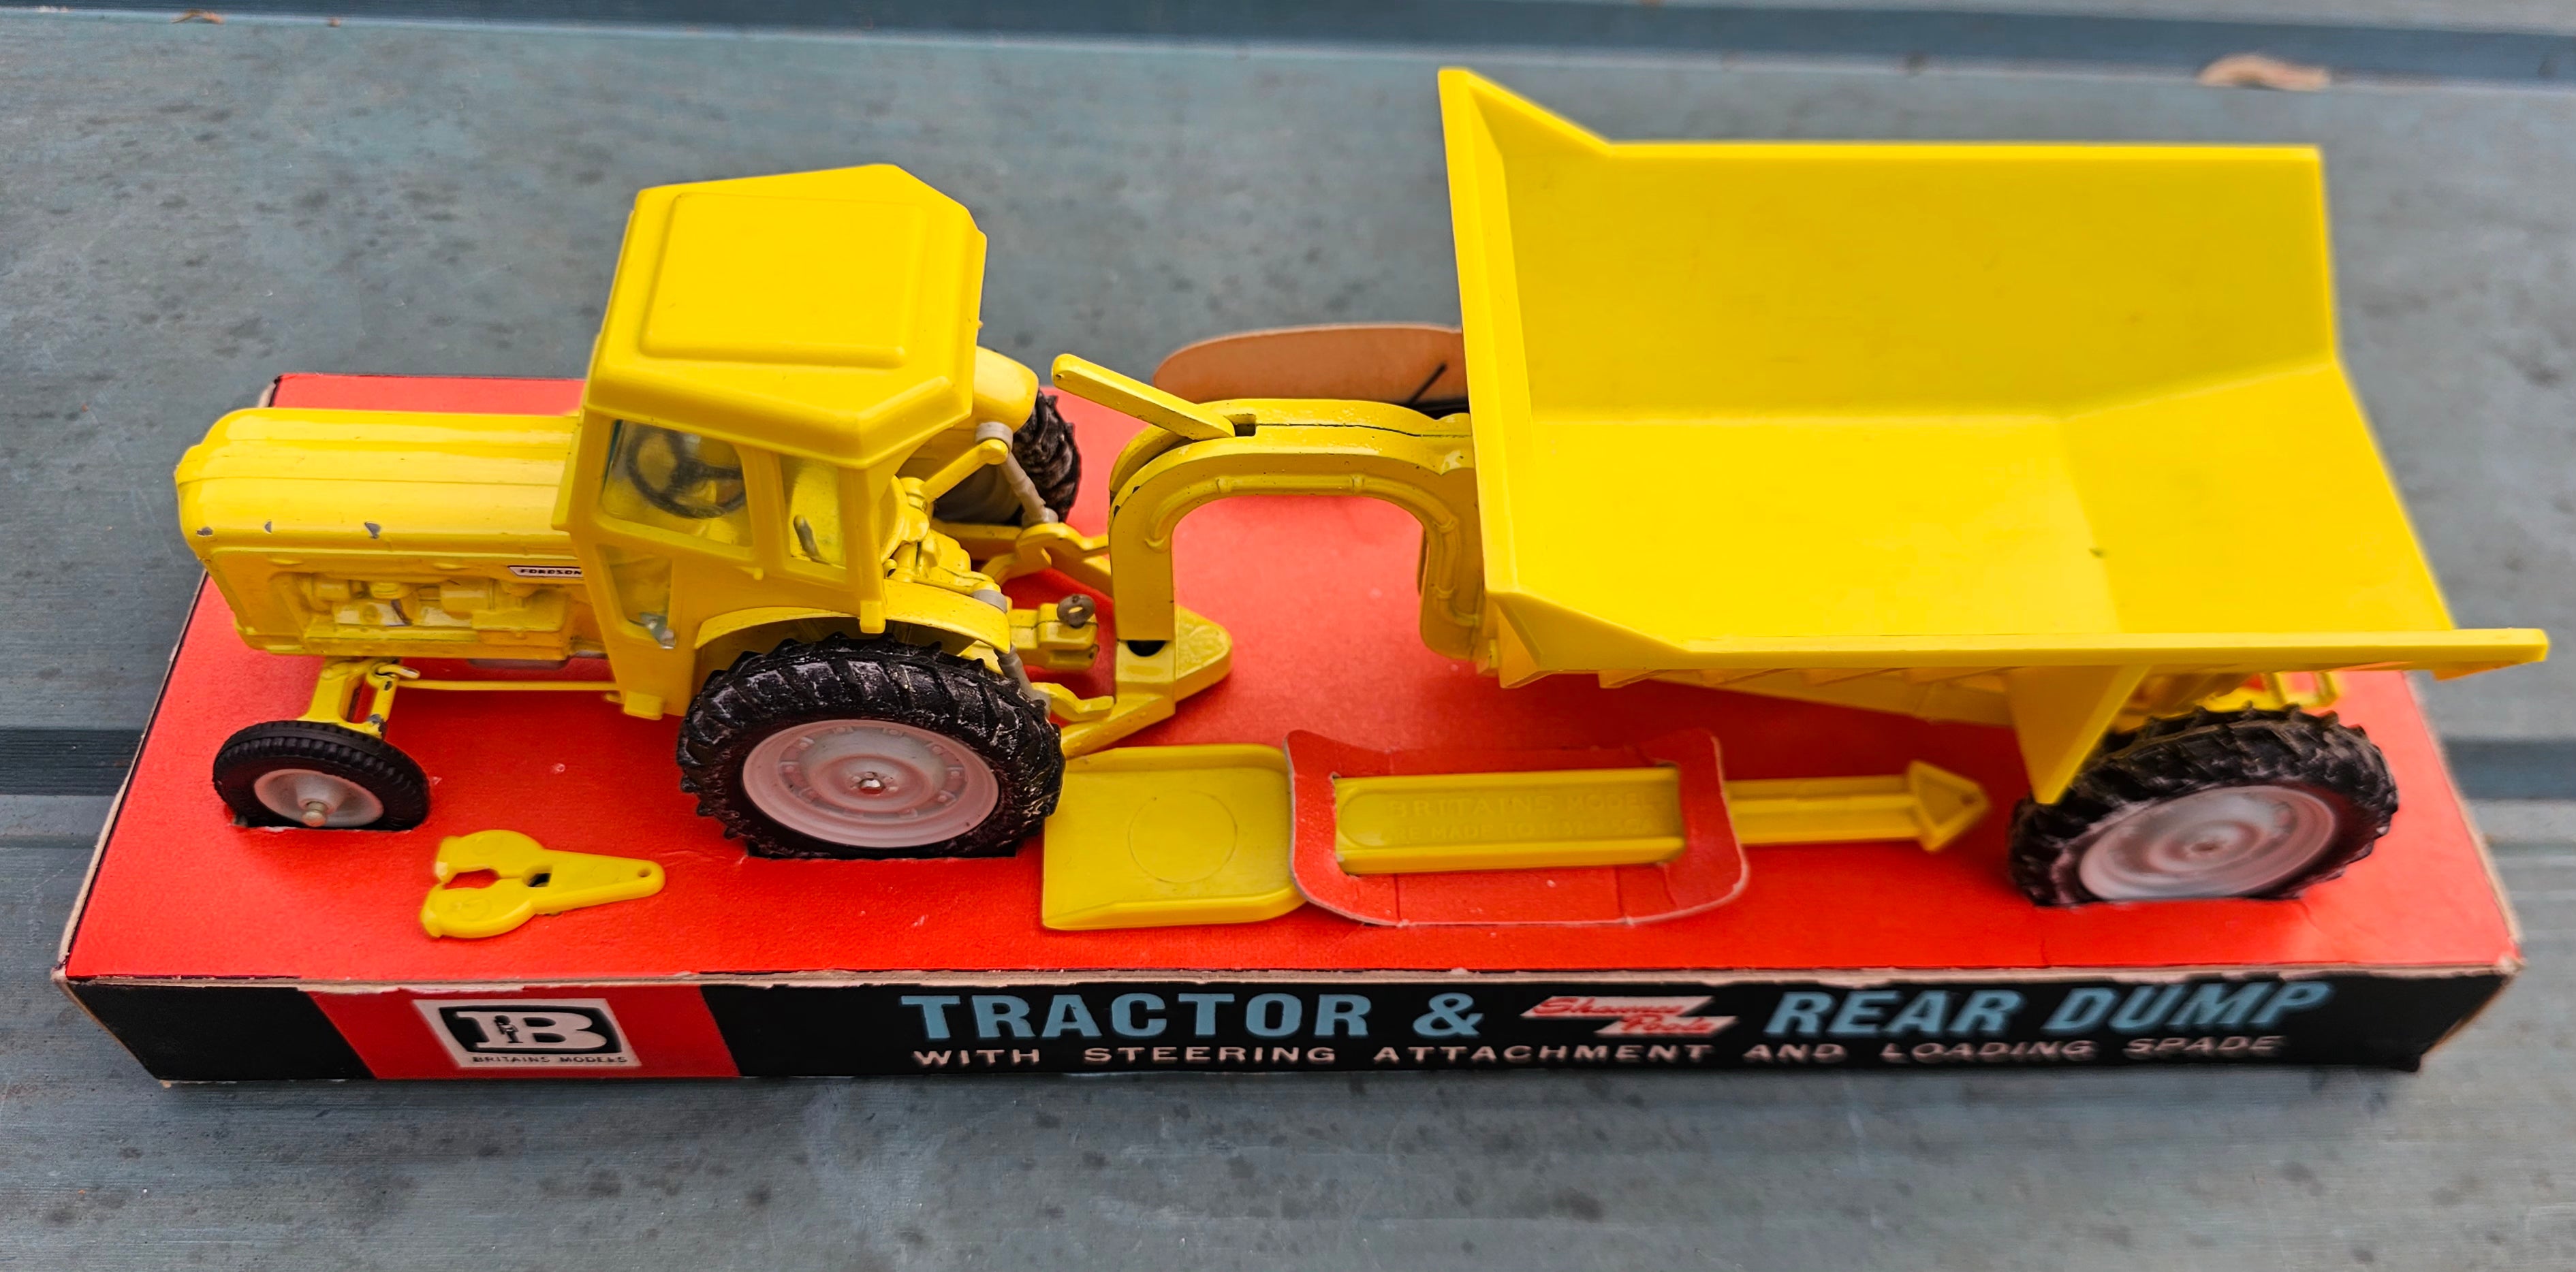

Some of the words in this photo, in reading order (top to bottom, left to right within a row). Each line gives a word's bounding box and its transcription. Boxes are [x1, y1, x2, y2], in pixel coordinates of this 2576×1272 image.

[1387, 793, 1555, 819] BRITAINS
[900, 992, 1372, 1038] TRACTOR
[1413, 992, 1485, 1037] &
[1763, 989, 2027, 1035] REAR
[2042, 981, 2334, 1033] DUMP
[472, 1055, 551, 1064] BRITAINS
[559, 1055, 628, 1064] MODELS
[913, 1047, 1041, 1067] WITH
[1083, 1046, 1336, 1064] STEERING
[1372, 1044, 1715, 1064] ATTACHMENT
[1742, 1043, 1849, 1063] AND
[1880, 1040, 2096, 1062] LOADING
[2123, 1035, 2286, 1060] SPADE
